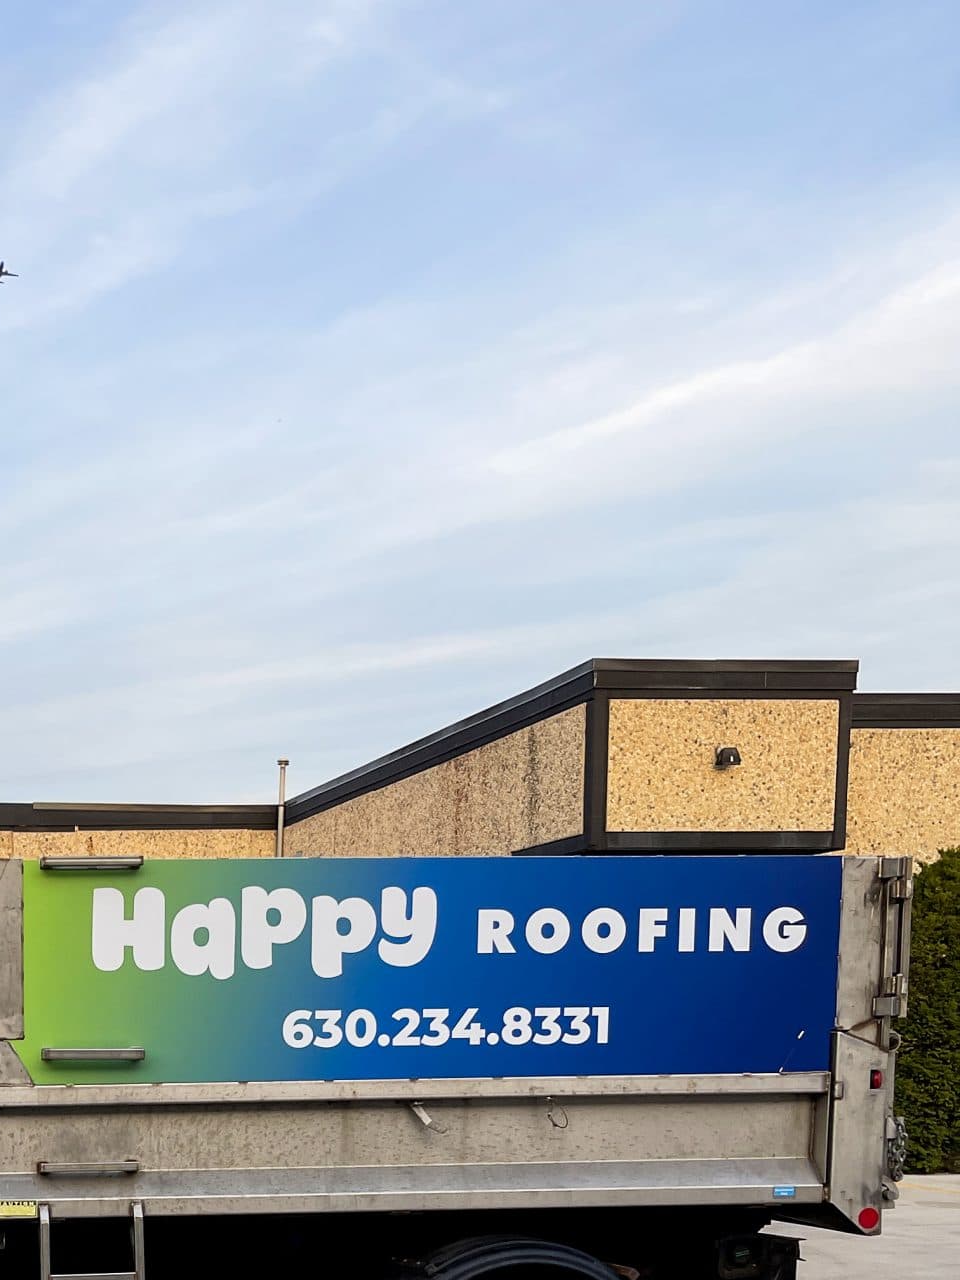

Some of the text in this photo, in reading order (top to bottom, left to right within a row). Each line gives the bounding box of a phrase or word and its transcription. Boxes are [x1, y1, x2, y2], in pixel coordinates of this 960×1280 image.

[91, 886, 807, 980] Happy ROOFING
[282, 1006, 610, 1049] 630.234.8331
